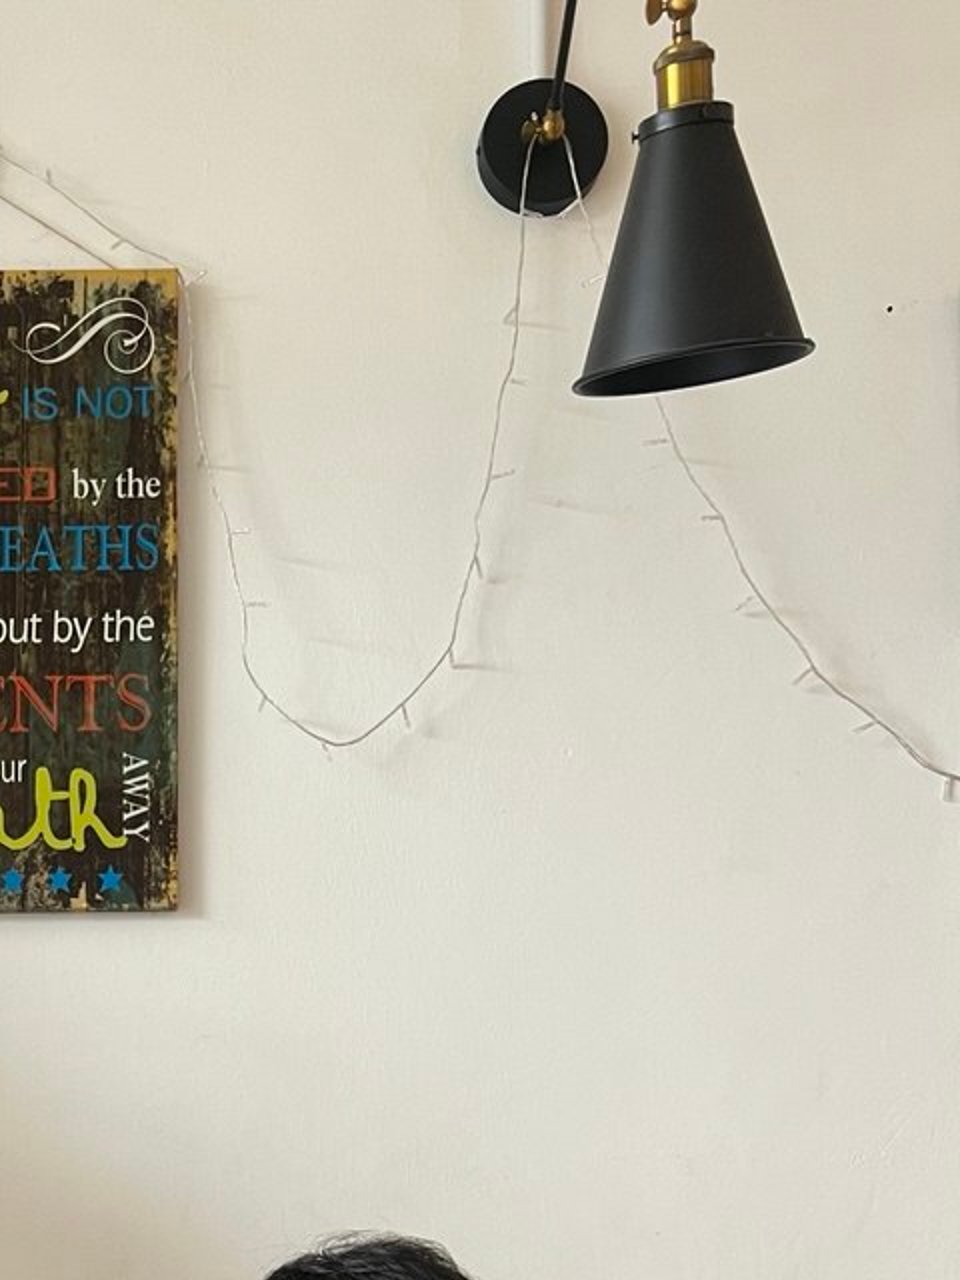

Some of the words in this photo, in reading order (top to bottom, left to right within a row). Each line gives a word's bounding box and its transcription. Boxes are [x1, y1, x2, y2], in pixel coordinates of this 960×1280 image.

[23, 386, 57, 420] IS
[77, 384, 155, 420] NOT
[71, 468, 107, 506] by
[116, 468, 161, 500] the
[53, 612, 92, 653] by
[102, 609, 155, 643] the
[122, 753, 150, 843] AWAY
